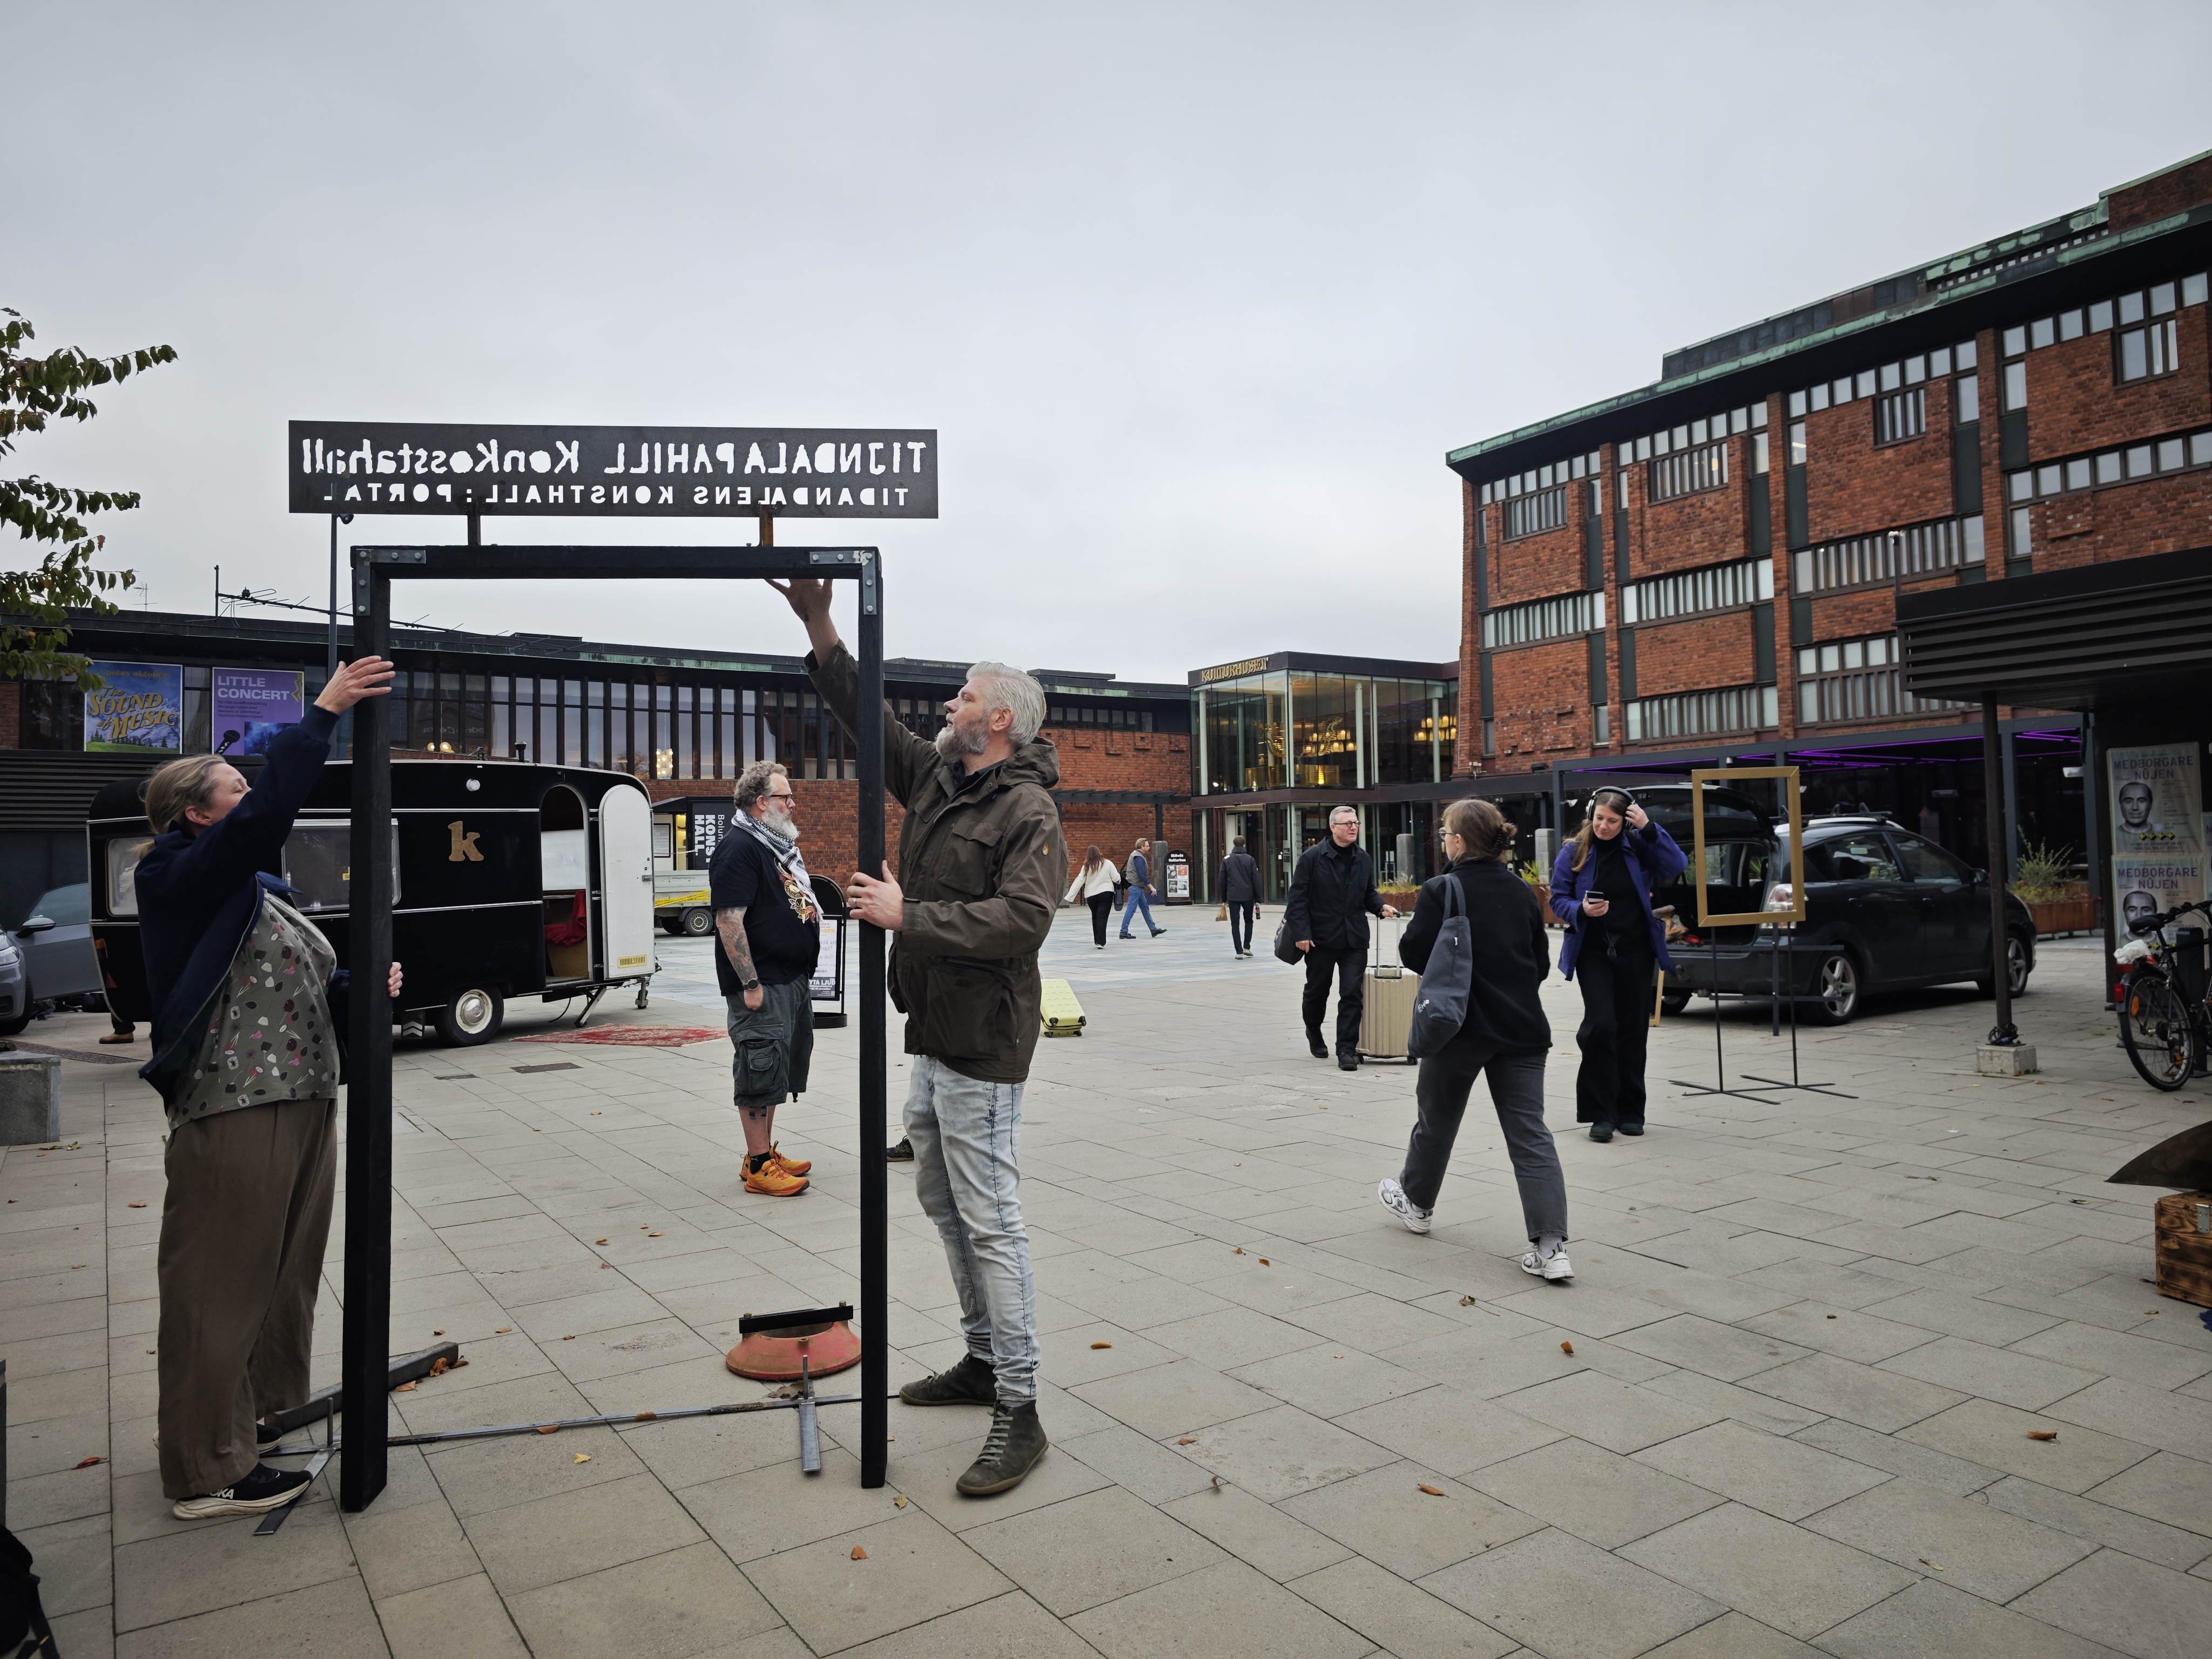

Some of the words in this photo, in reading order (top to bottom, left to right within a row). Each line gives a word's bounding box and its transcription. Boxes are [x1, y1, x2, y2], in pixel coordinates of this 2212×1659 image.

[1202, 657, 1269, 682] KULTURHUSET
[218, 676, 265, 687] LITTLE
[102, 685, 125, 697] The
[218, 688, 289, 700] CONCERT
[89, 692, 163, 716] SOUND
[97, 717, 112, 730] of
[109, 710, 177, 740] MUSIC
[2114, 756, 2194, 771] MEDBORGARE
[448, 820, 484, 861] k
[694, 814, 705, 856] HALL.
[2118, 867, 2198, 878] MEDBORGARE
[210, 1488, 234, 1499] KA
